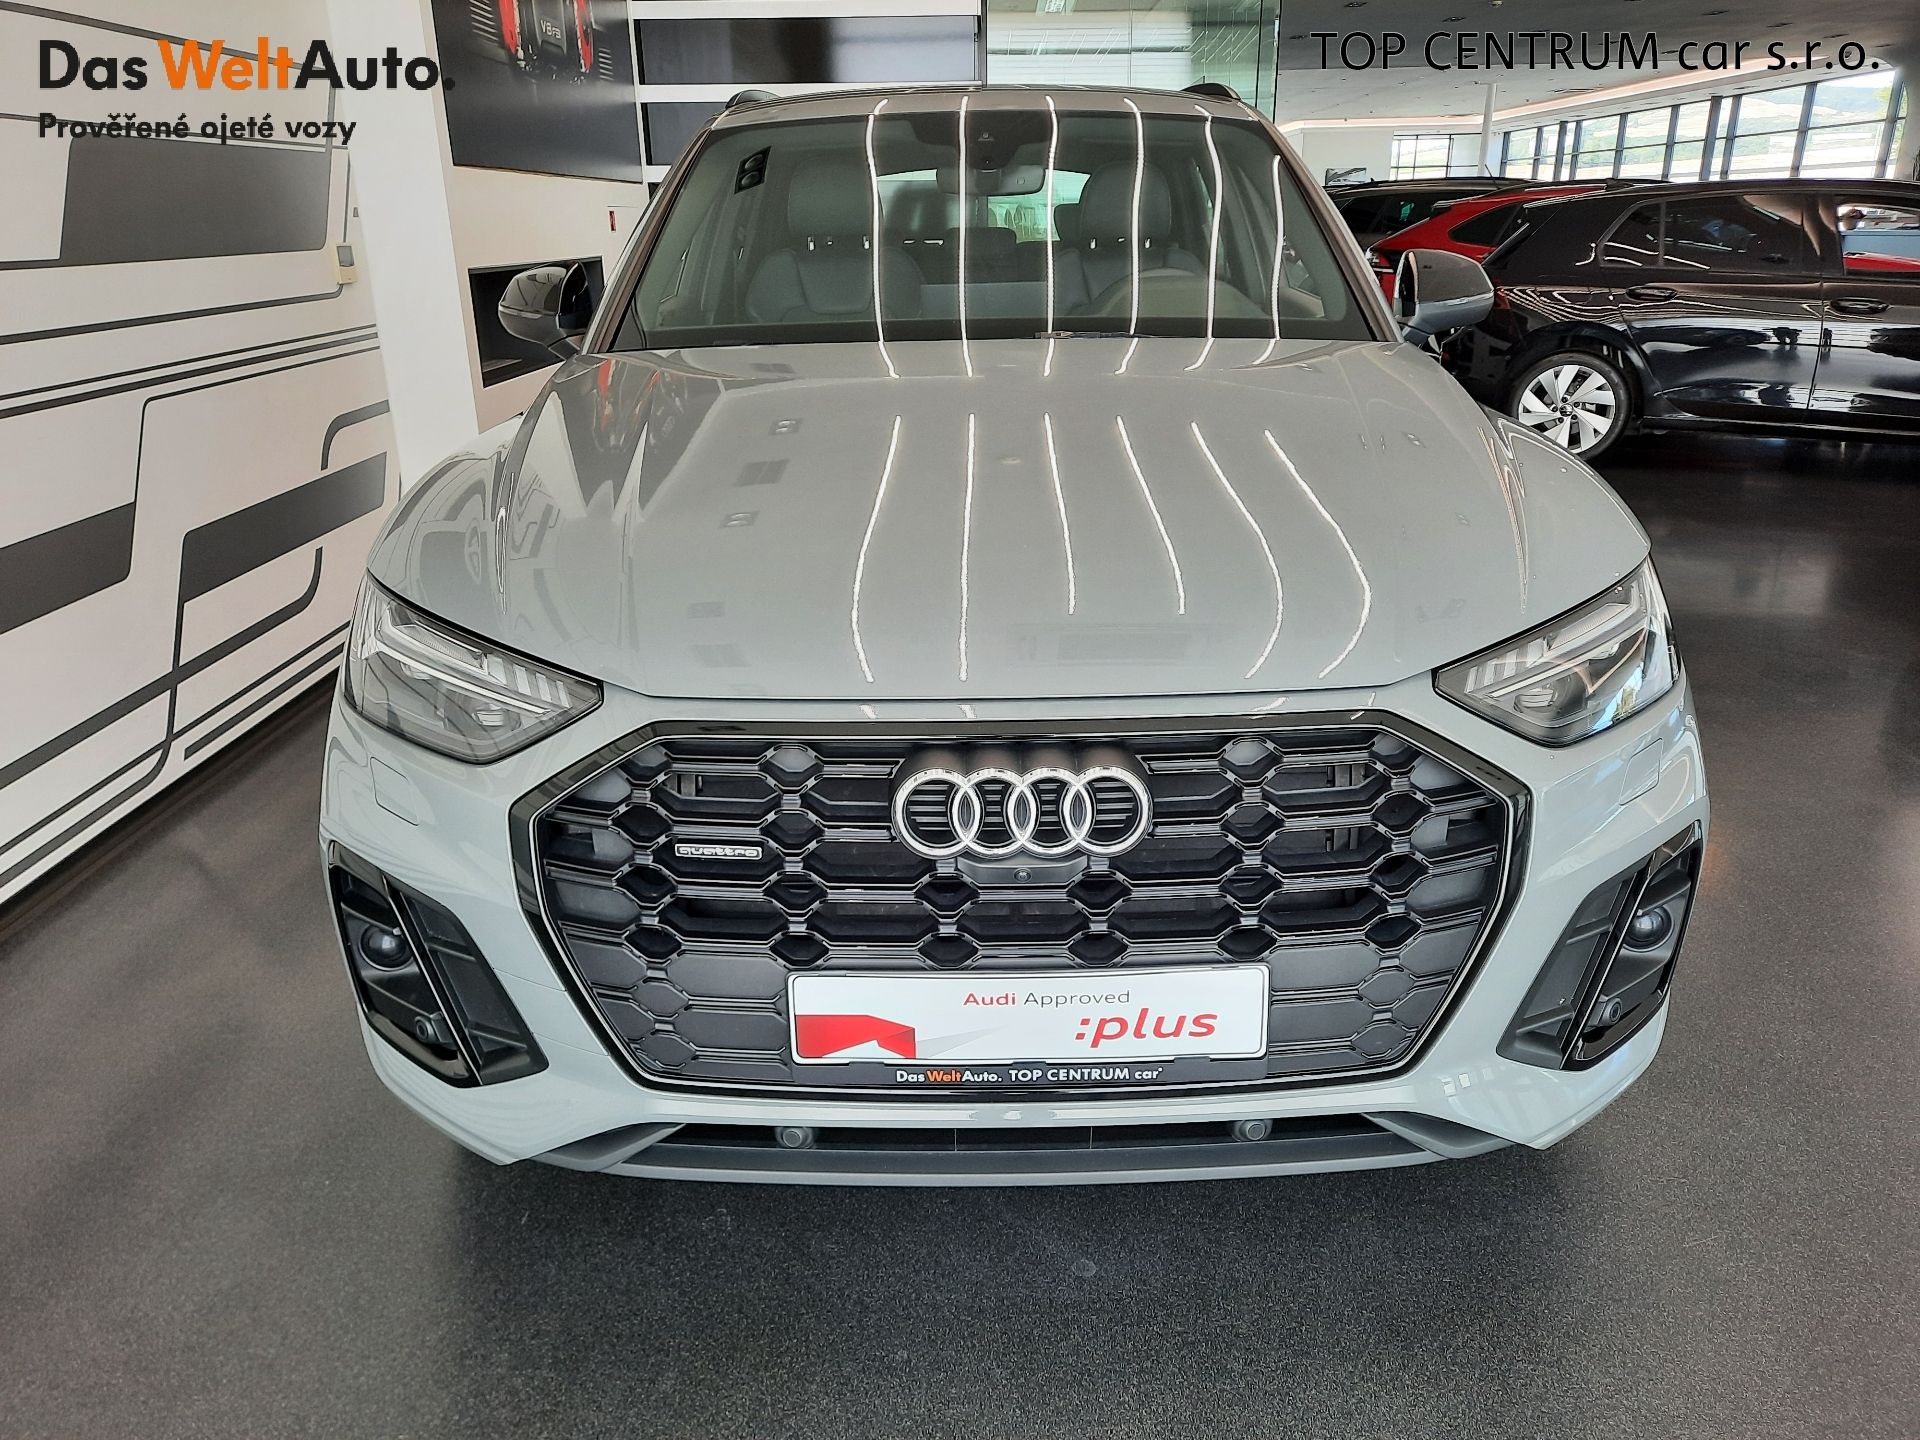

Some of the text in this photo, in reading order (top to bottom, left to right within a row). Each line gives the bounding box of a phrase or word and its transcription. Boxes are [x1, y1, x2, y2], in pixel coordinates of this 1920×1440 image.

[679, 847, 758, 857] quattro
[963, 989, 1131, 1009] Audi Approved
[896, 1070, 925, 1083] Das
[1009, 1068, 1043, 1082] TOP
[1046, 1066, 1130, 1082] CENTRUM
